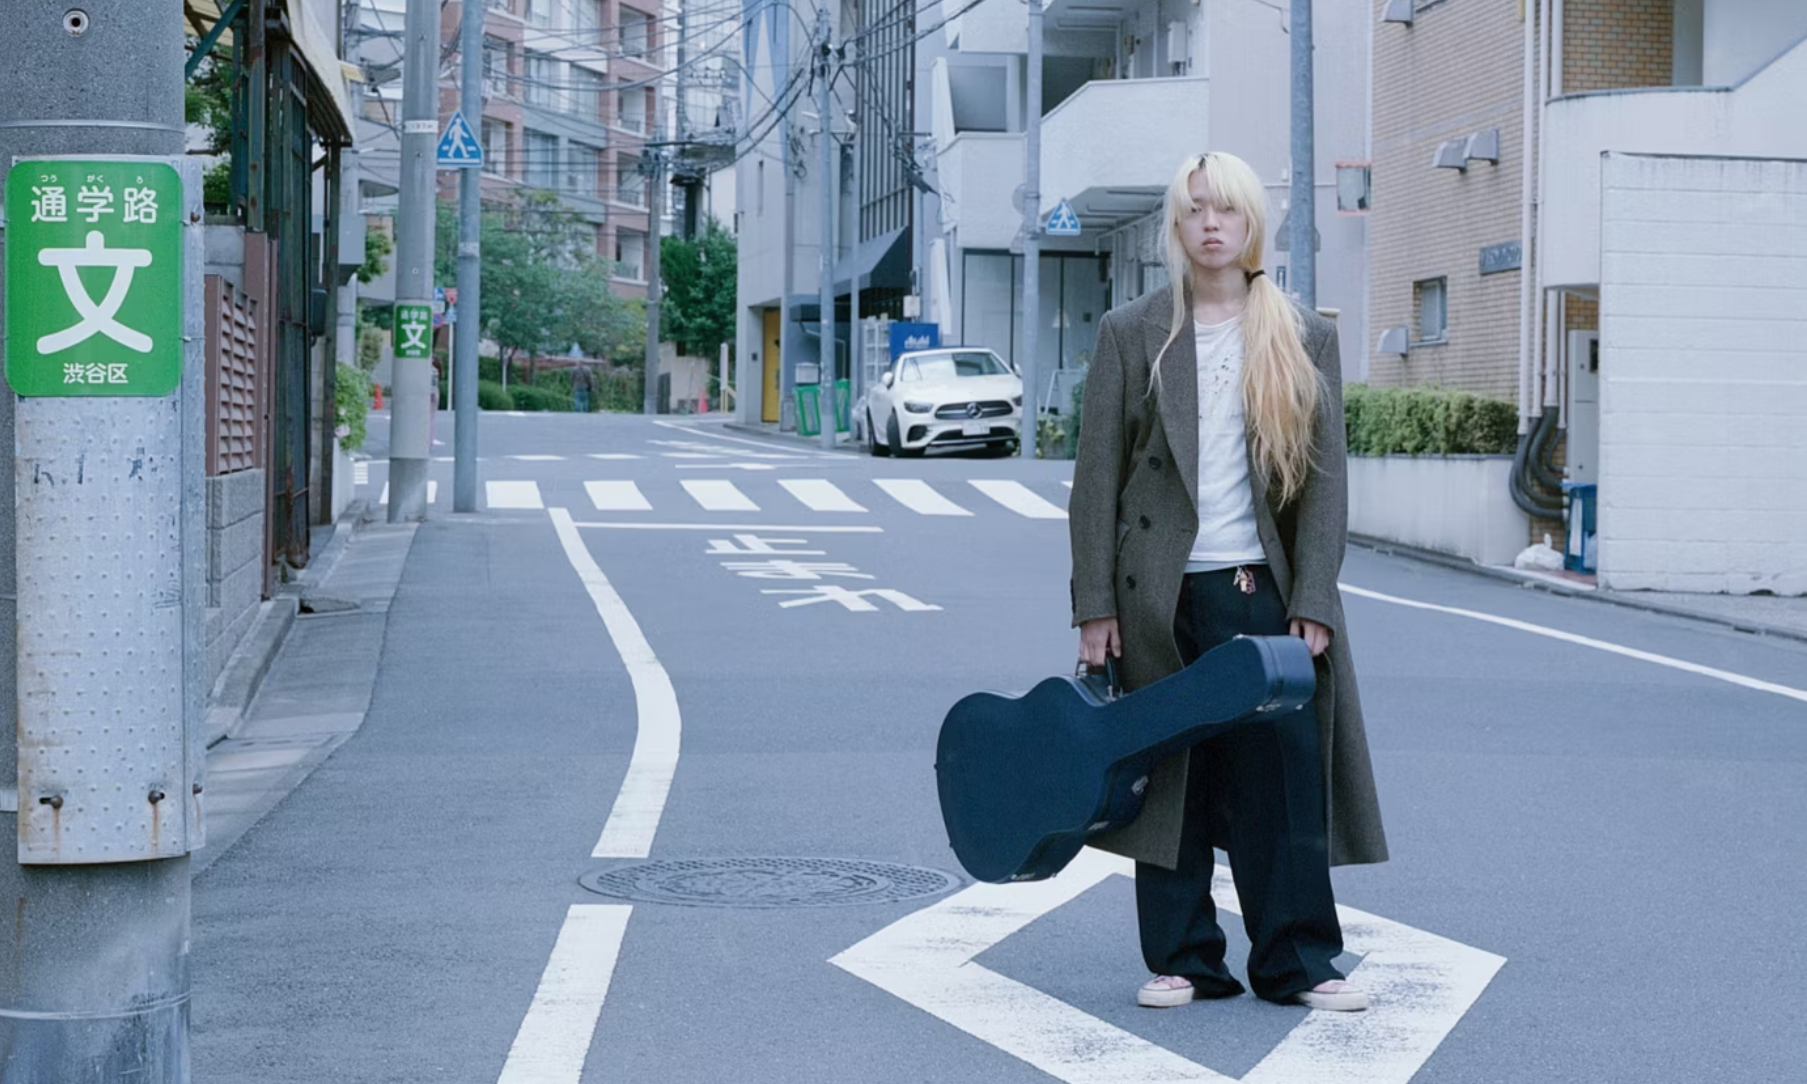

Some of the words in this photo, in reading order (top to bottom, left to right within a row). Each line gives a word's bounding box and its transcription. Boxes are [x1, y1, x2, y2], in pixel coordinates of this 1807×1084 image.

[40, 174, 58, 183] つう
[86, 174, 104, 183] がく
[136, 175, 144, 184] ろ
[31, 185, 158, 224] 通学路
[36, 230, 153, 355] 文
[400, 320, 427, 349] 文
[63, 362, 129, 384] 渋谷区
[705, 533, 944, 612] 止まれ
